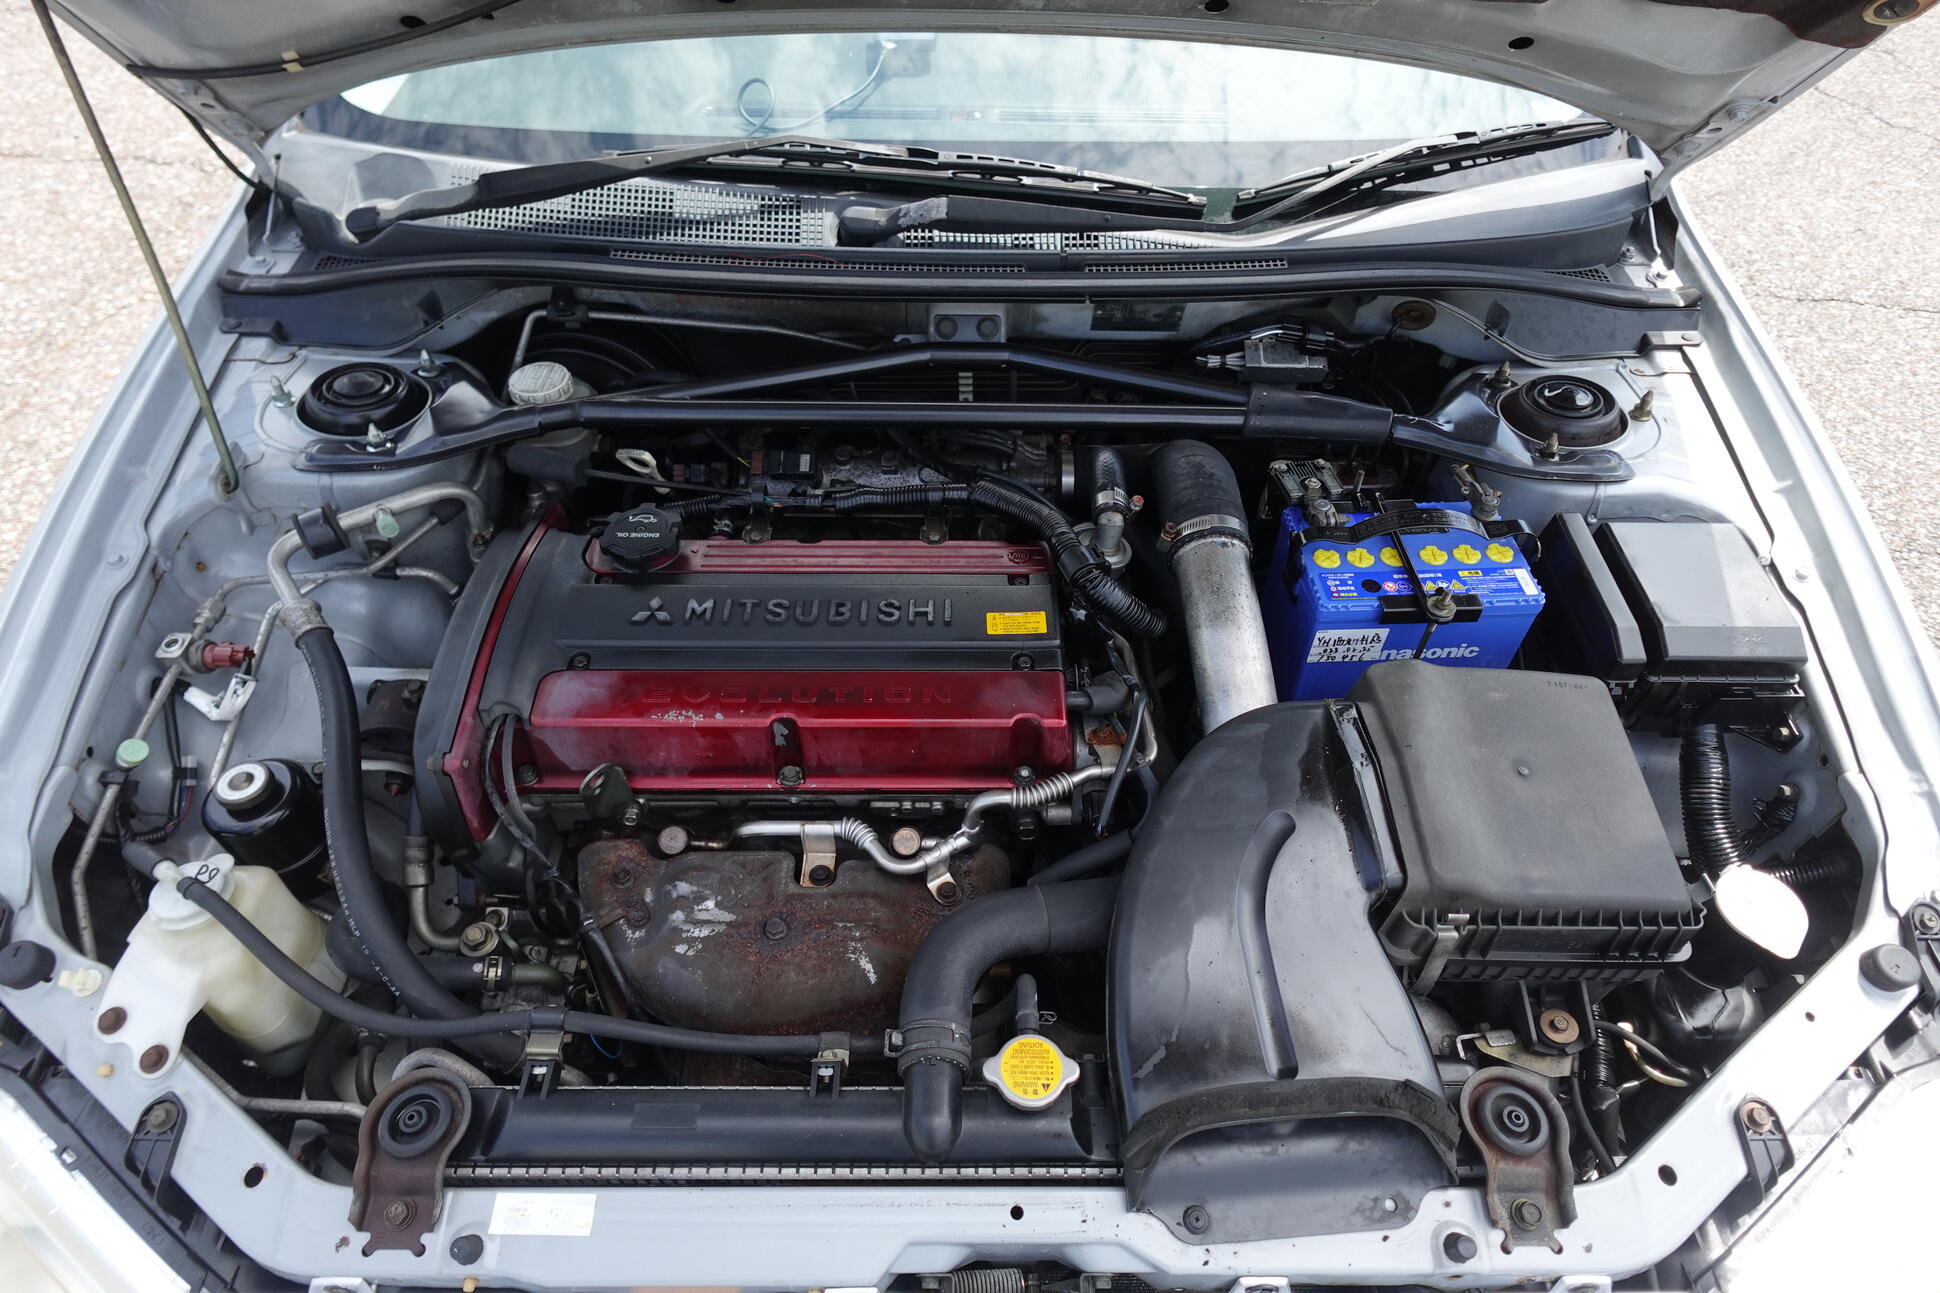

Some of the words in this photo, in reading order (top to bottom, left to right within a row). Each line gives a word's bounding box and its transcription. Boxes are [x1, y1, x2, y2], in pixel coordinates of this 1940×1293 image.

[684, 599, 952, 623] MITSUBISHI
[1380, 643, 1480, 660] naonic
[640, 687, 952, 704] EVOLUTION
